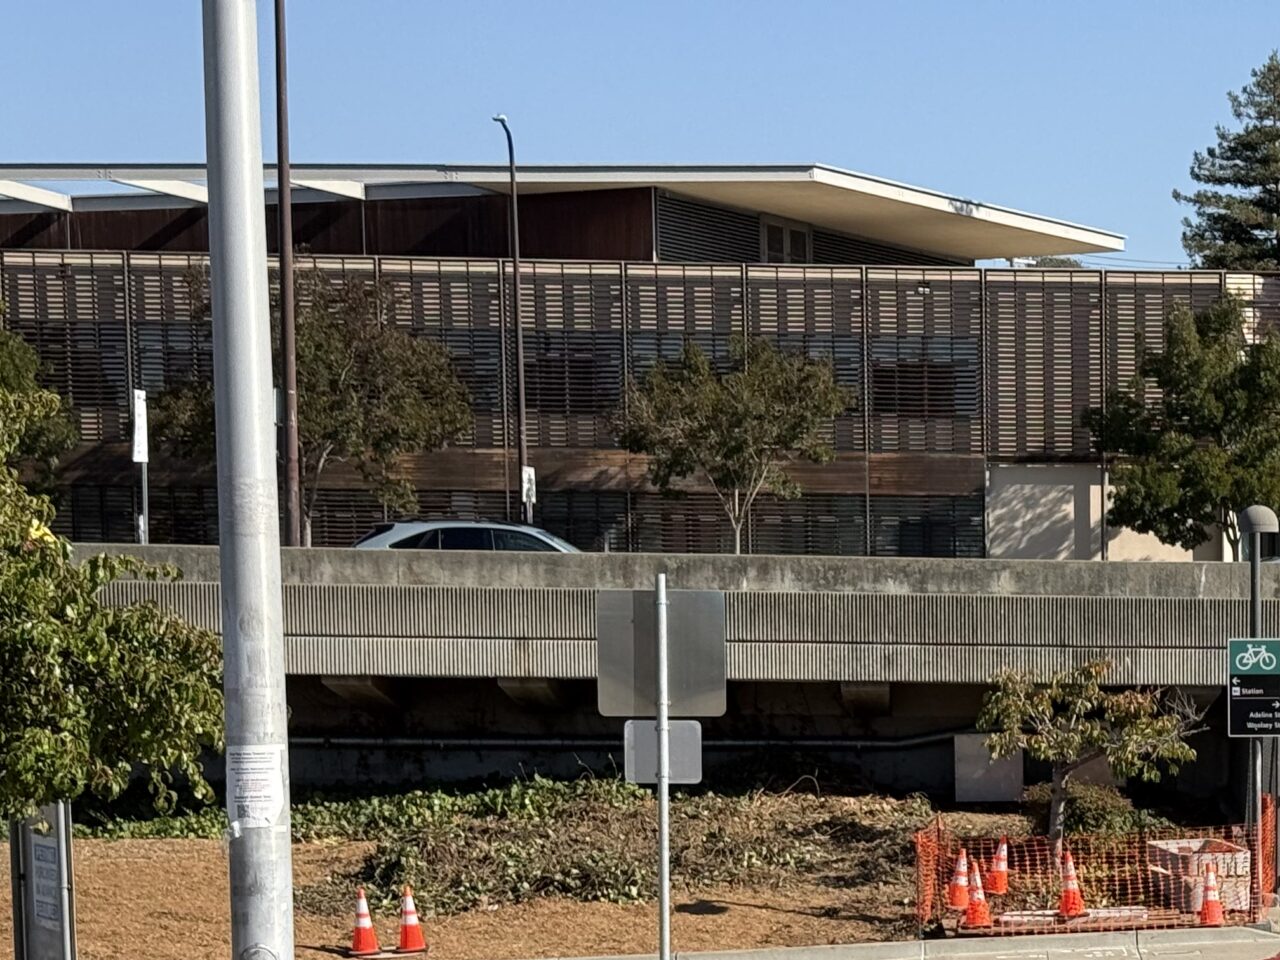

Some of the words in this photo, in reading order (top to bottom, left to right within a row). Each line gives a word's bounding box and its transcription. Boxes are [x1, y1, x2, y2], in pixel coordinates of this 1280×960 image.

[1249, 711, 1273, 719] Adeline
[1274, 711, 1280, 719] St
[1274, 721, 1280, 729] St
